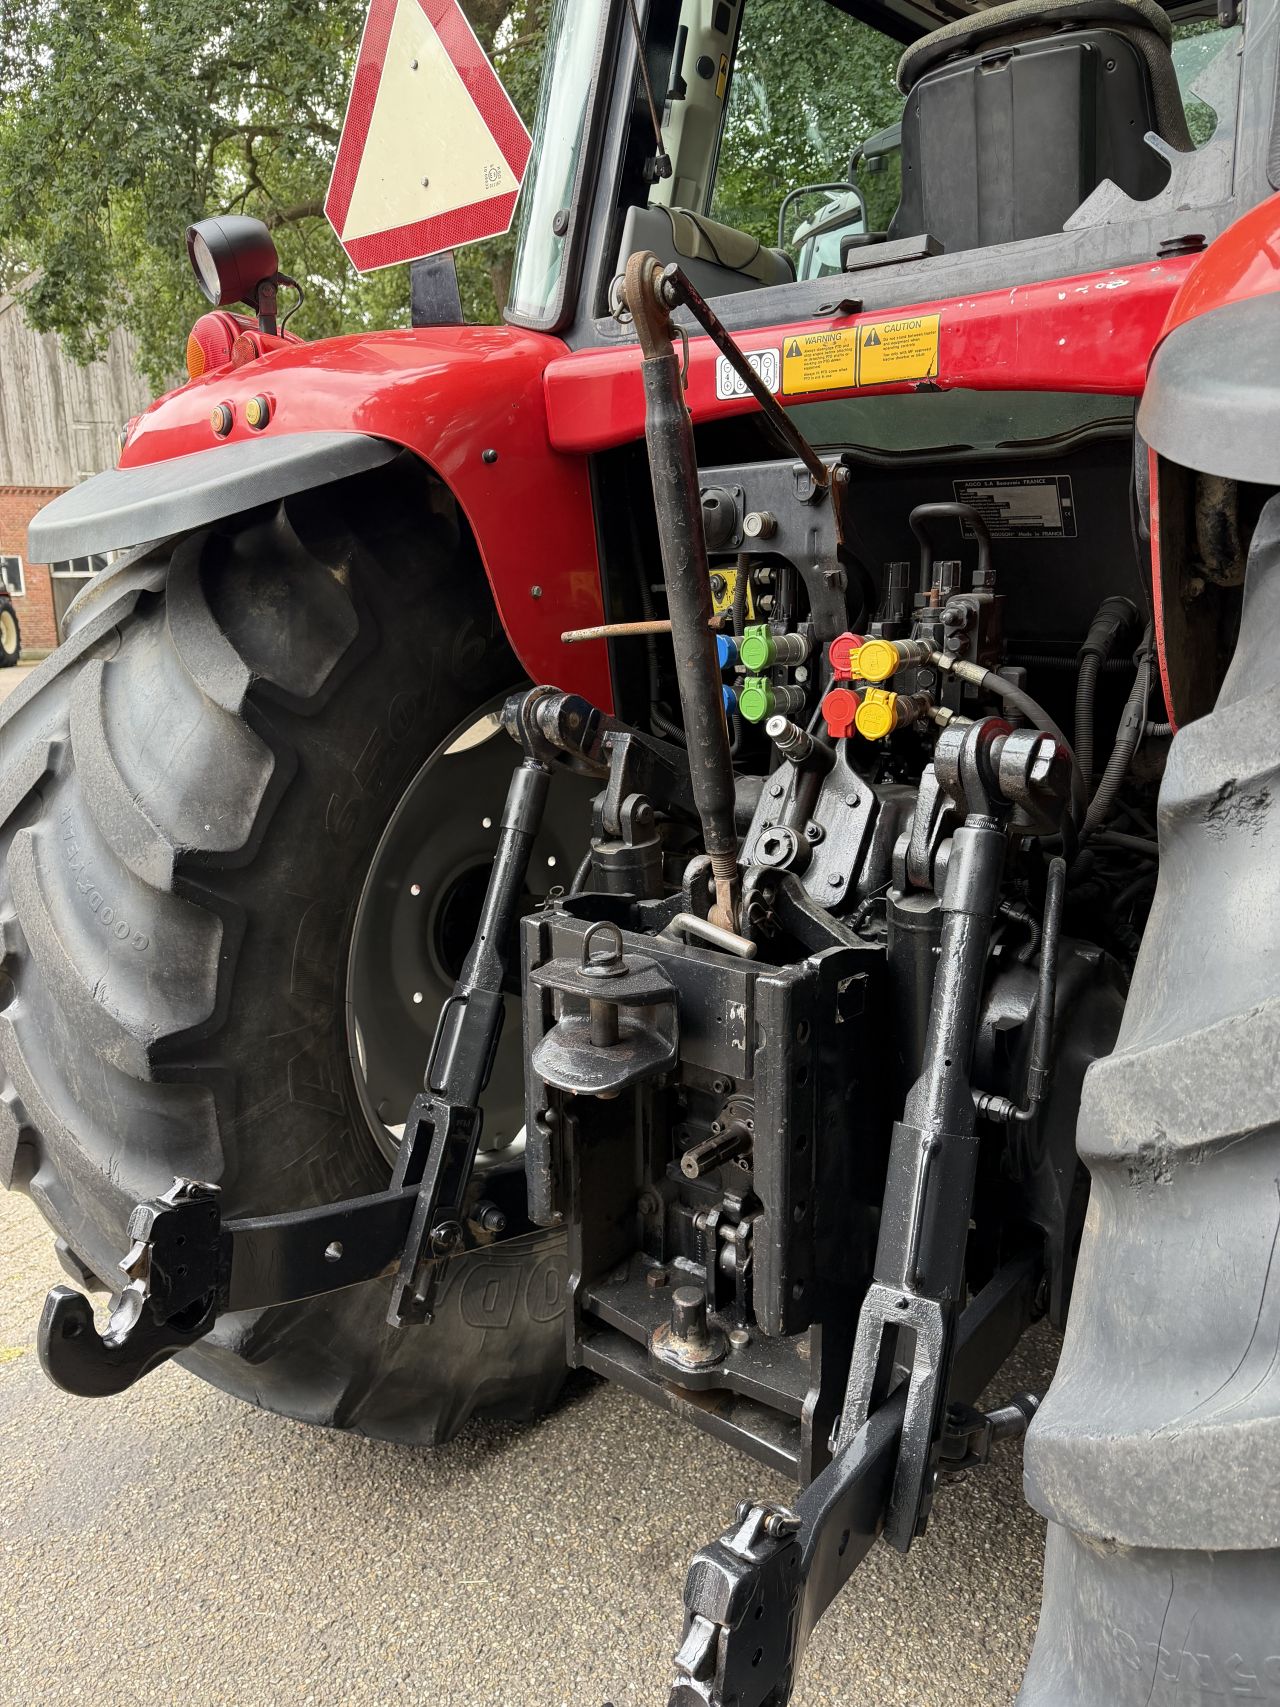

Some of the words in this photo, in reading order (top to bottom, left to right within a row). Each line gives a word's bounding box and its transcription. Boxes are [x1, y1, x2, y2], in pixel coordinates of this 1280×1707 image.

[884, 320, 922, 333] CAUTION
[805, 333, 842, 345] WARNING
[60, 805, 150, 952] GOODYEAR
